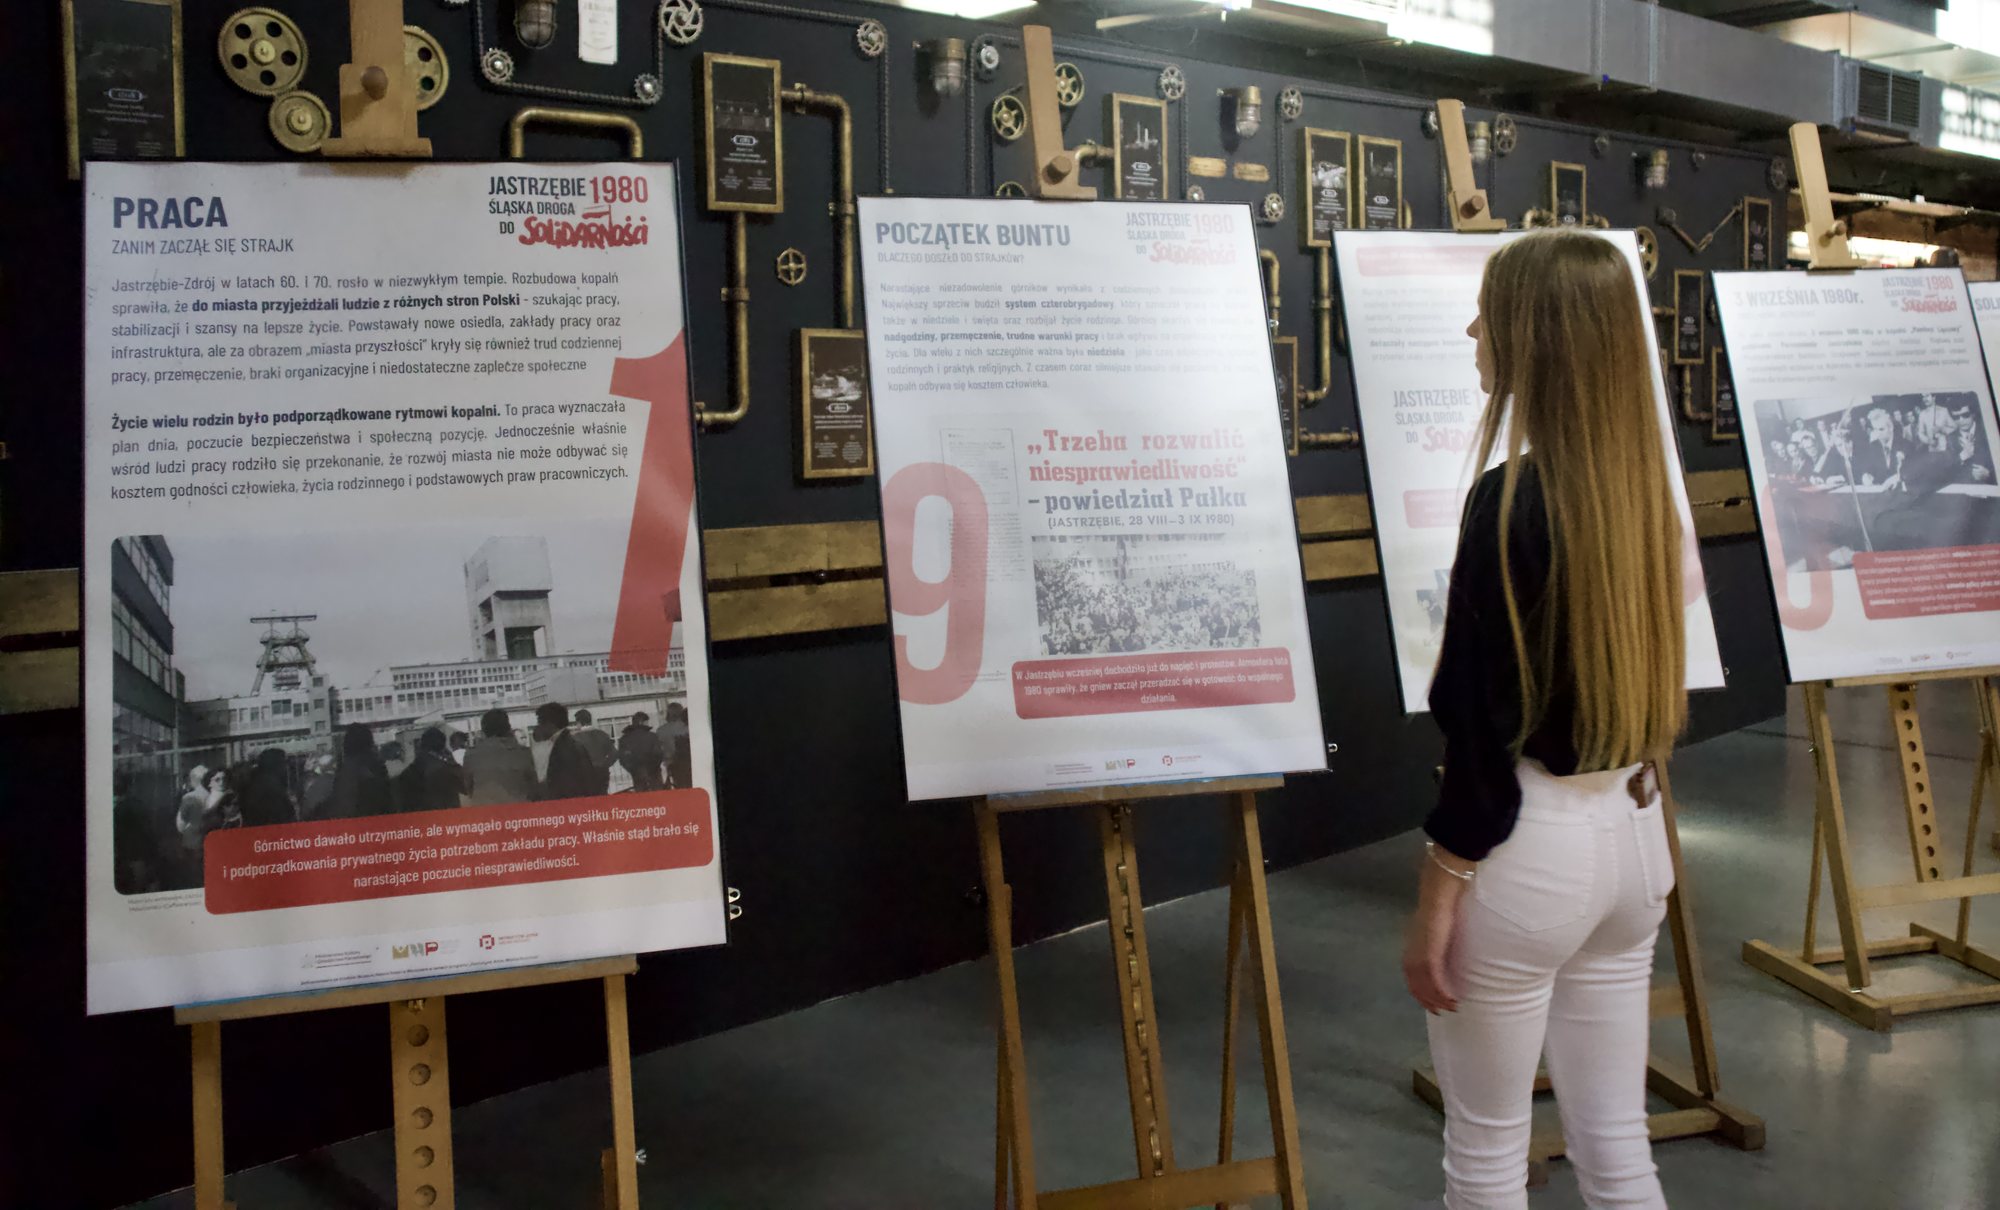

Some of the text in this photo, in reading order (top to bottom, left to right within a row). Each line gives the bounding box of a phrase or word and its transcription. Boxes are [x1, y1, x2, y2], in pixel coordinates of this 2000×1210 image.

[488, 176, 648, 204] JASTRZĘBIE 1980
[113, 196, 228, 229] PRACA
[489, 198, 576, 216] ŚLĄSKA DROGA
[500, 221, 514, 234] DO
[876, 221, 1070, 249] POCZĄTEK BUNTU
[1126, 212, 1234, 234] JASTRZĘBIE 1980
[111, 237, 294, 256] ZANIM ZACZĄŁ SIĘ STRAJK
[877, 251, 923, 262] DLACZEGO
[959, 252, 973, 262] DO
[973, 252, 1024, 262] STRAJKÓW?
[111, 276, 216, 293] Jastrzębie-Zdrój
[236, 275, 275, 288] latach
[279, 275, 299, 288] 60.
[312, 275, 332, 288] 70.
[336, 276, 368, 288] rosło
[388, 273, 458, 288] niezwykłym
[463, 272, 507, 286] tempie.
[511, 271, 577, 284] Rozbudowa
[580, 271, 618, 286] kopalń
[111, 300, 170, 316] sprawiła,
[173, 302, 188, 312] że
[191, 299, 208, 311] do
[211, 298, 258, 311] miasta
[260, 297, 339, 314] przyjeżdżali
[342, 297, 380, 310] ludzie
[393, 294, 443, 310] różnych
[446, 295, 479, 306] stron
[482, 293, 520, 305] Polski
[532, 292, 582, 308] szukając
[585, 295, 620, 307] pracy,
[111, 322, 181, 339] stabilizacji
[194, 324, 237, 336] szansy
[242, 323, 258, 333] na
[263, 320, 303, 336] lepsze
[308, 323, 343, 335] życie.
[348, 317, 419, 332] Powstawały
[424, 318, 455, 328] nowe
[459, 315, 504, 328] osiedla,
[509, 314, 555, 329] zakłady
[560, 316, 592, 329] pracy
[596, 316, 621, 326] oraz
[110, 344, 204, 358] infrastruktura,
[207, 344, 226, 357] ale
[229, 346, 244, 357] za
[248, 343, 302, 356] obrazem
[430, 338, 461, 353] kryły
[464, 340, 482, 351] się
[485, 339, 530, 350] również
[533, 337, 557, 349] trud
[560, 336, 622, 351] codziennej
[110, 371, 150, 385] pracy,
[154, 369, 246, 384] przemęczenie,
[249, 366, 281, 379] braki
[284, 364, 369, 380] organizacyjne
[379, 360, 470, 374] niedostateczne
[473, 359, 524, 375] zaplecze
[527, 359, 586, 374] społeczne
[1393, 388, 1472, 408] JASTRZĘBIE
[111, 400, 625, 432] Życie wielu rodzin było podporządkowane rytmowi kopalni. To praca wyznaczała
[1027, 427, 1246, 455] „Trzeba rozwalić
[110, 484, 166, 499] kosztem
[168, 481, 228, 500] godności
[230, 479, 299, 494] człowieka,
[301, 480, 334, 494] życia
[337, 475, 405, 492] rodzinnego
[415, 470, 504, 488] podstawowych
[506, 471, 536, 484] praw
[539, 464, 628, 483] pracowniczych.
[608, 329, 697, 676] 1
[1045, 486, 1173, 514] powiedział
[1181, 485, 1247, 508] Pałka
[1048, 516, 1124, 530] (JASTRZĘBIE,
[1129, 515, 1143, 526] 28
[1190, 514, 1202, 526] IX
[1206, 513, 1234, 527] 1980)
[881, 462, 988, 705] 9
[253, 803, 666, 852] Górnictwo dawało utrzymanie, ale wymagało ogromnego wysiłku fizycznego
[229, 854, 338, 880] podporządkowania
[339, 850, 406, 870] prywatnego
[408, 848, 438, 863] życia
[439, 840, 498, 860] potrzebom
[501, 835, 545, 851] zakładu
[546, 834, 580, 849] pracy.
[582, 828, 625, 843] Właśnie
[626, 826, 650, 841] stąd
[652, 823, 681, 837] brało
[682, 824, 699, 836] się
[353, 853, 579, 889] narastające poczucie niesprawiedliwości.
